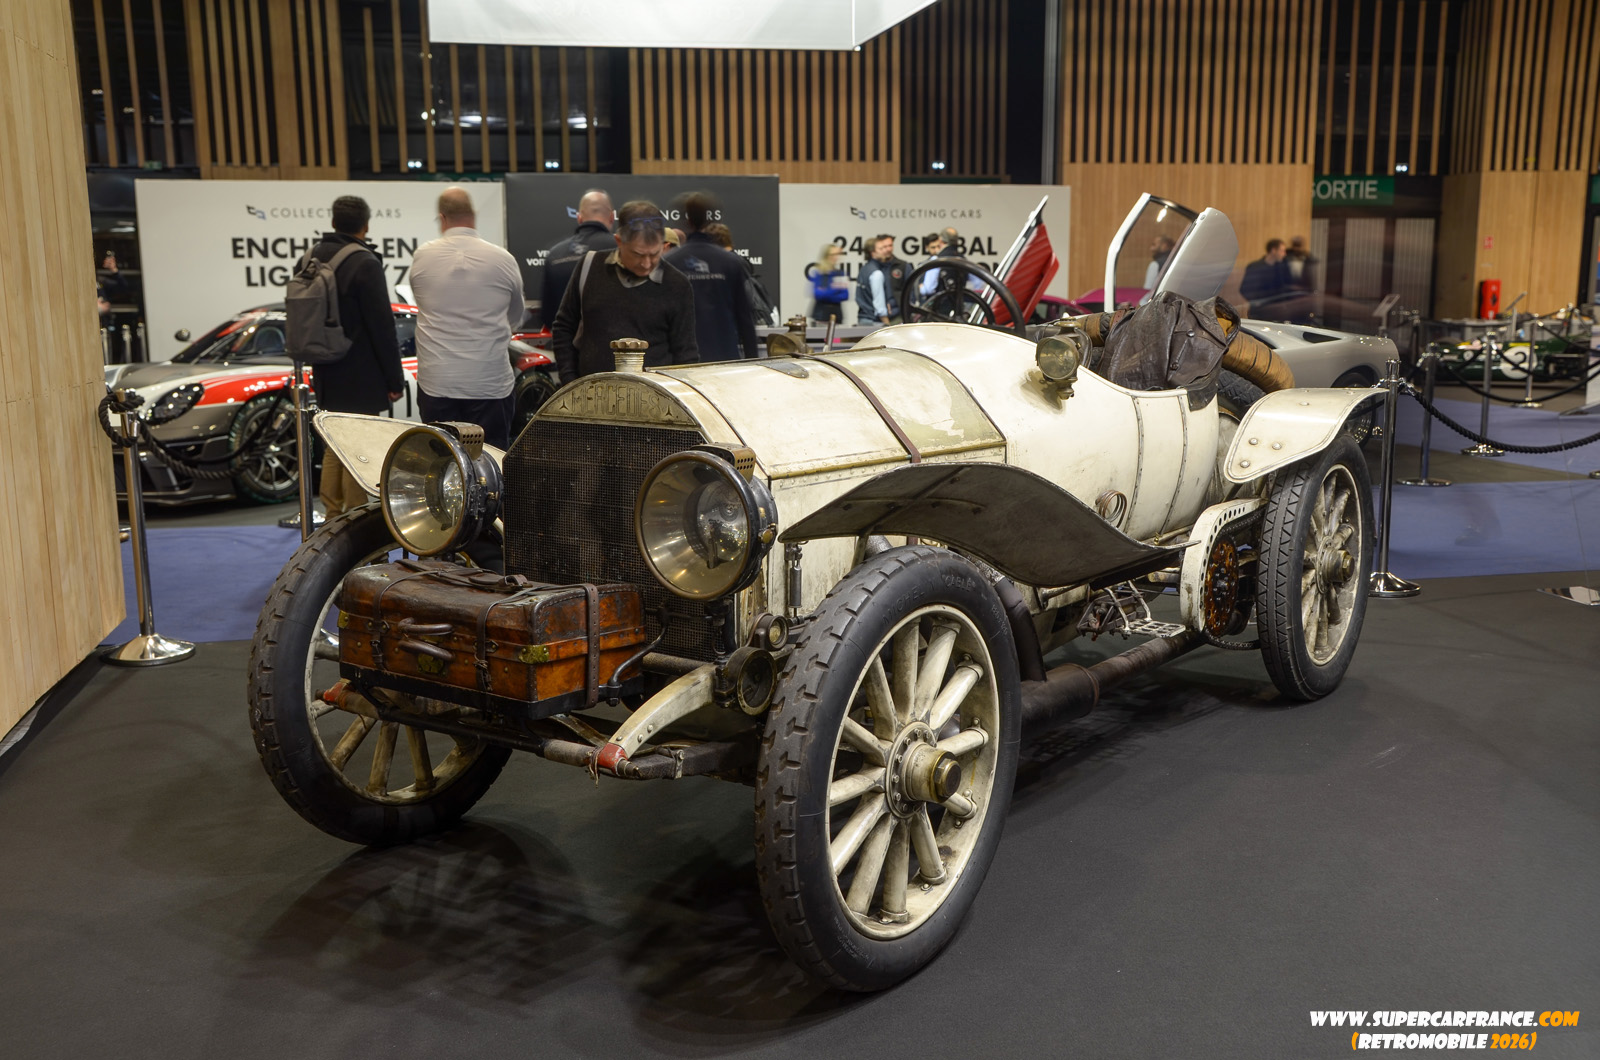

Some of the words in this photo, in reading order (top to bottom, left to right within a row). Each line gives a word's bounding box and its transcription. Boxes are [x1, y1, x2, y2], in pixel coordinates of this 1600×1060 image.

[369, 207, 402, 218] ARS
[870, 208, 946, 219] COLLECTING
[951, 208, 982, 219] CARS
[901, 236, 998, 256] GLBAL
[571, 384, 662, 417] MERCEDES
